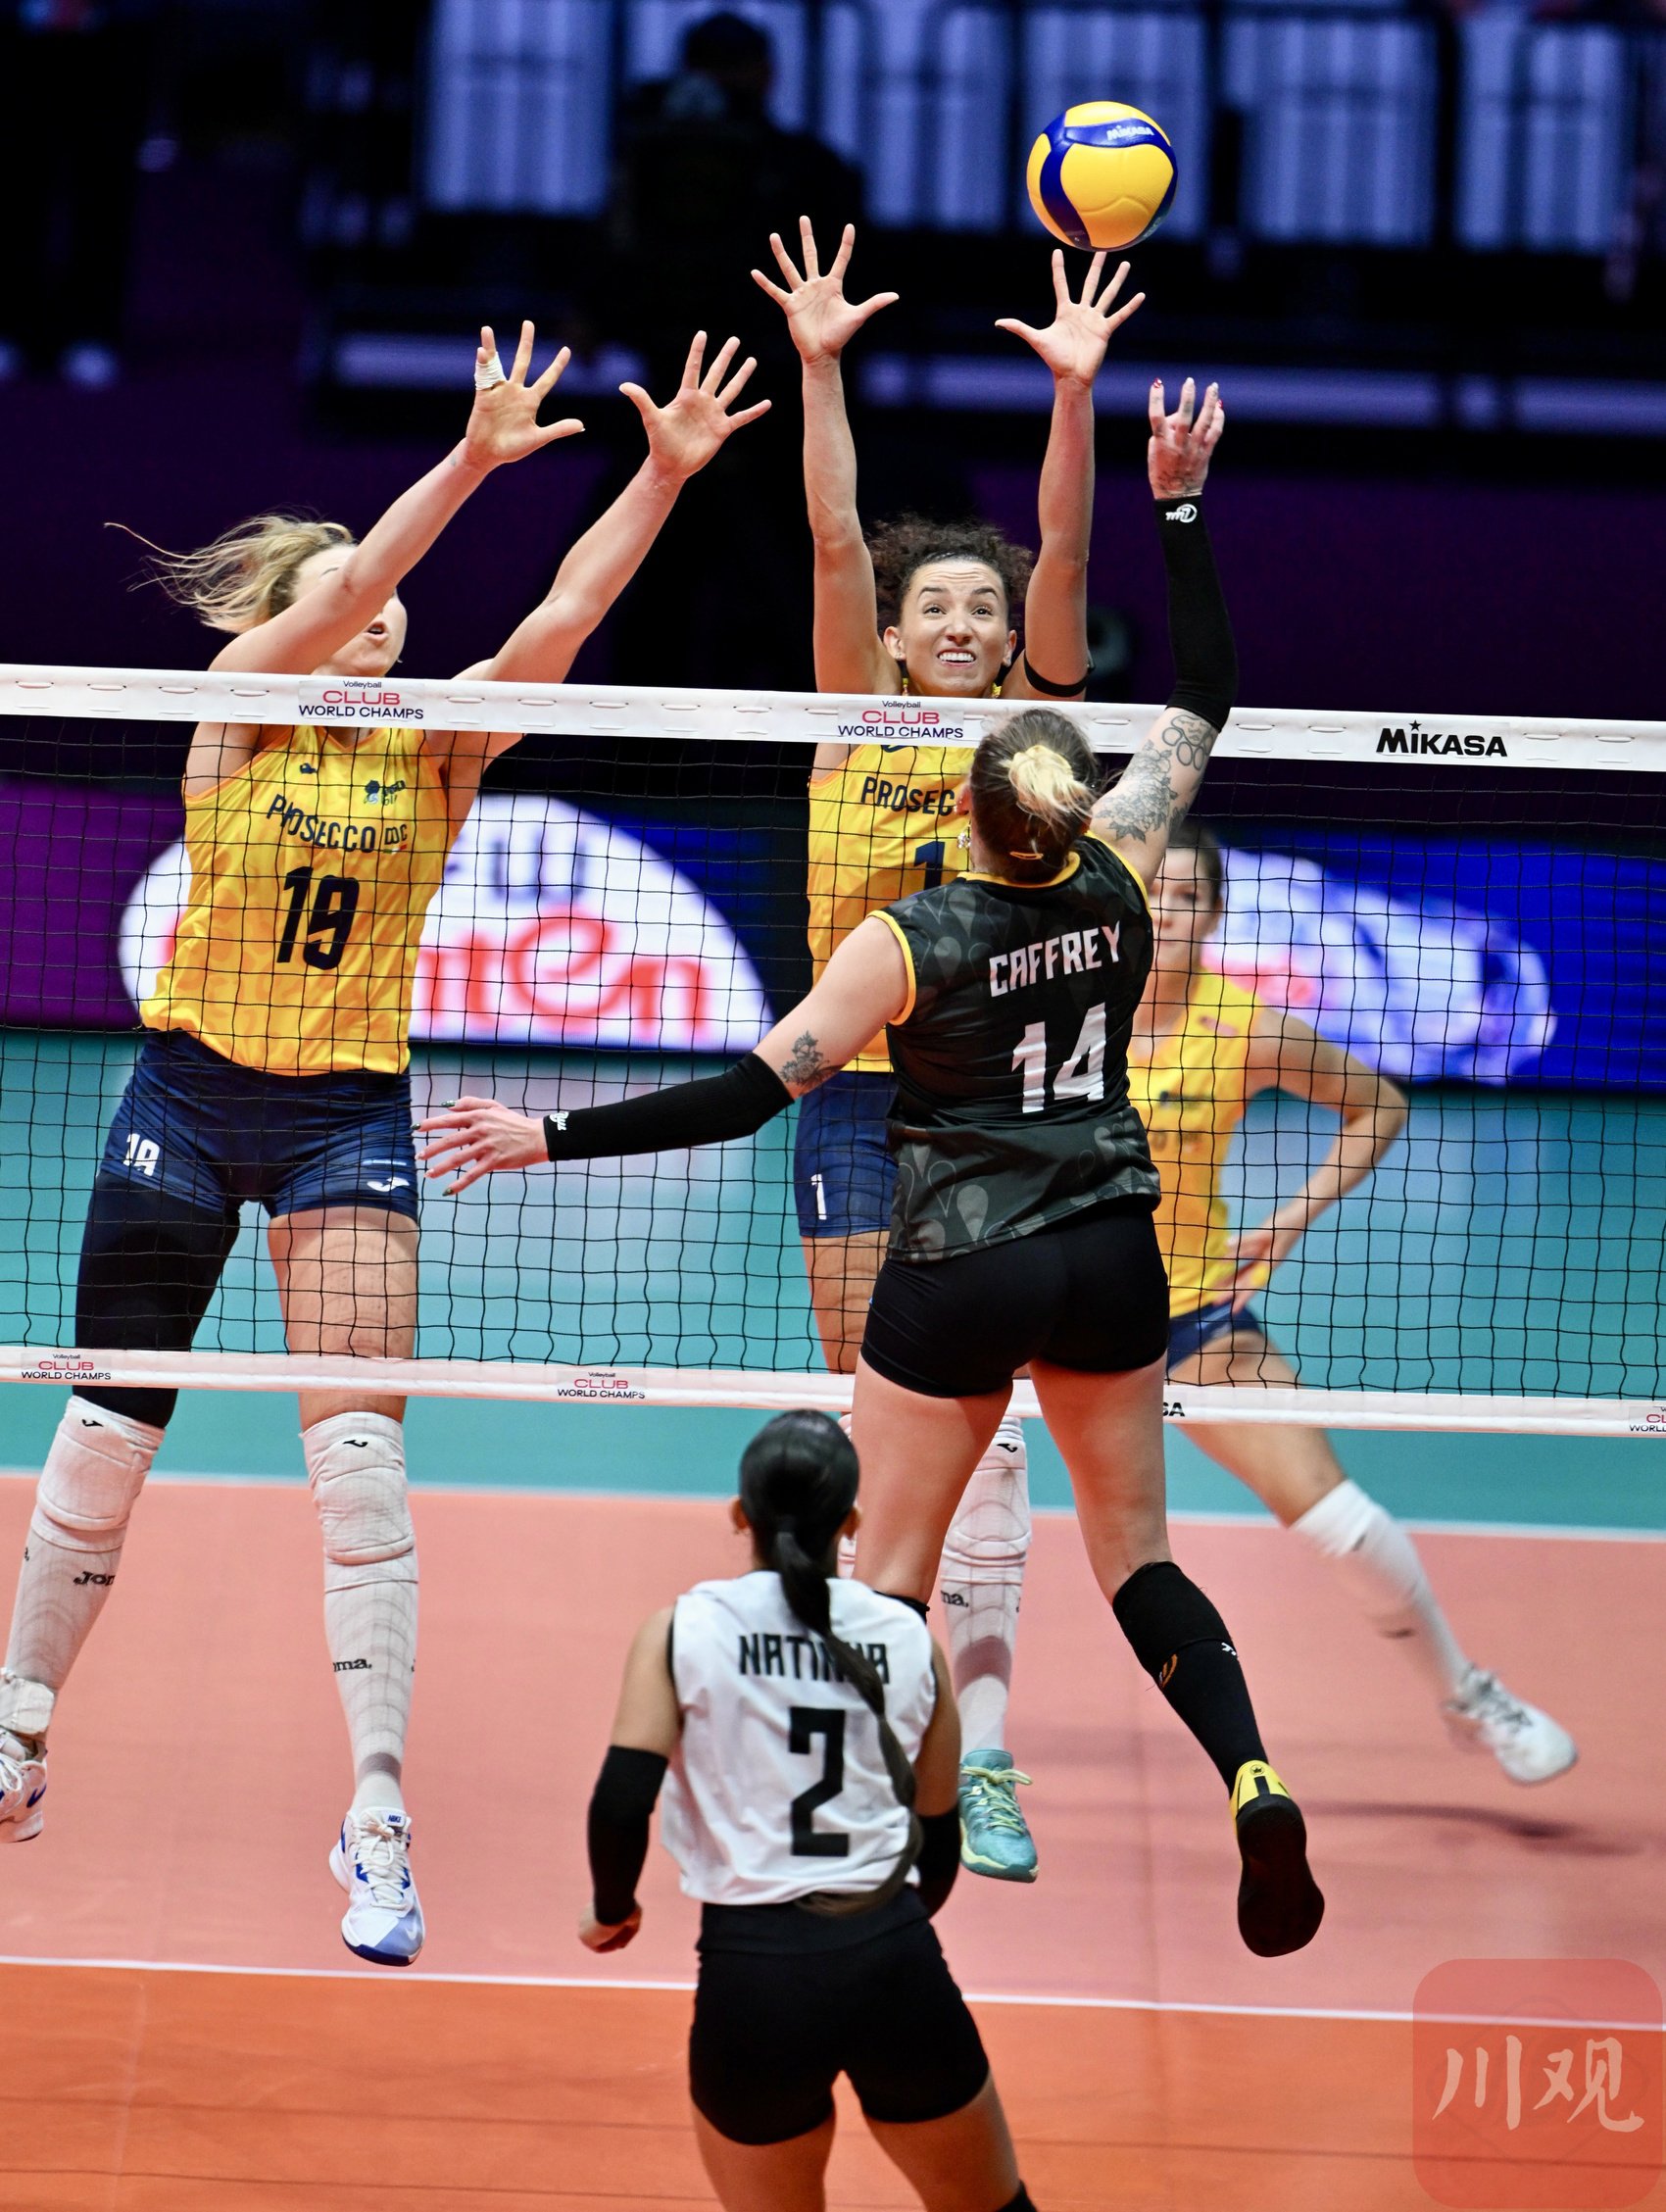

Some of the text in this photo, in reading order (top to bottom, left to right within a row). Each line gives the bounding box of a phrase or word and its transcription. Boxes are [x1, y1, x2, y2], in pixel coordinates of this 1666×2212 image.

[343, 680, 382, 689] Volleyball
[322, 690, 401, 706] CLUB
[882, 700, 921, 710] Volleyball
[299, 705, 424, 720] WORLD CHAMPS
[862, 711, 940, 724] CLUB
[838, 725, 963, 739] WORLD CHAMPS
[276, 865, 360, 970] 19
[989, 920, 1120, 998] CAFFREY
[1011, 1002, 1106, 1113] 14
[810, 1173, 827, 1220] 1
[38, 1360, 94, 1371] CLUB
[22, 1371, 111, 1381] WORLD CHAMPS
[573, 1378, 629, 1390] CLUB
[558, 1389, 646, 1400] WORLD CHAMPS
[789, 1706, 850, 1857] 2
